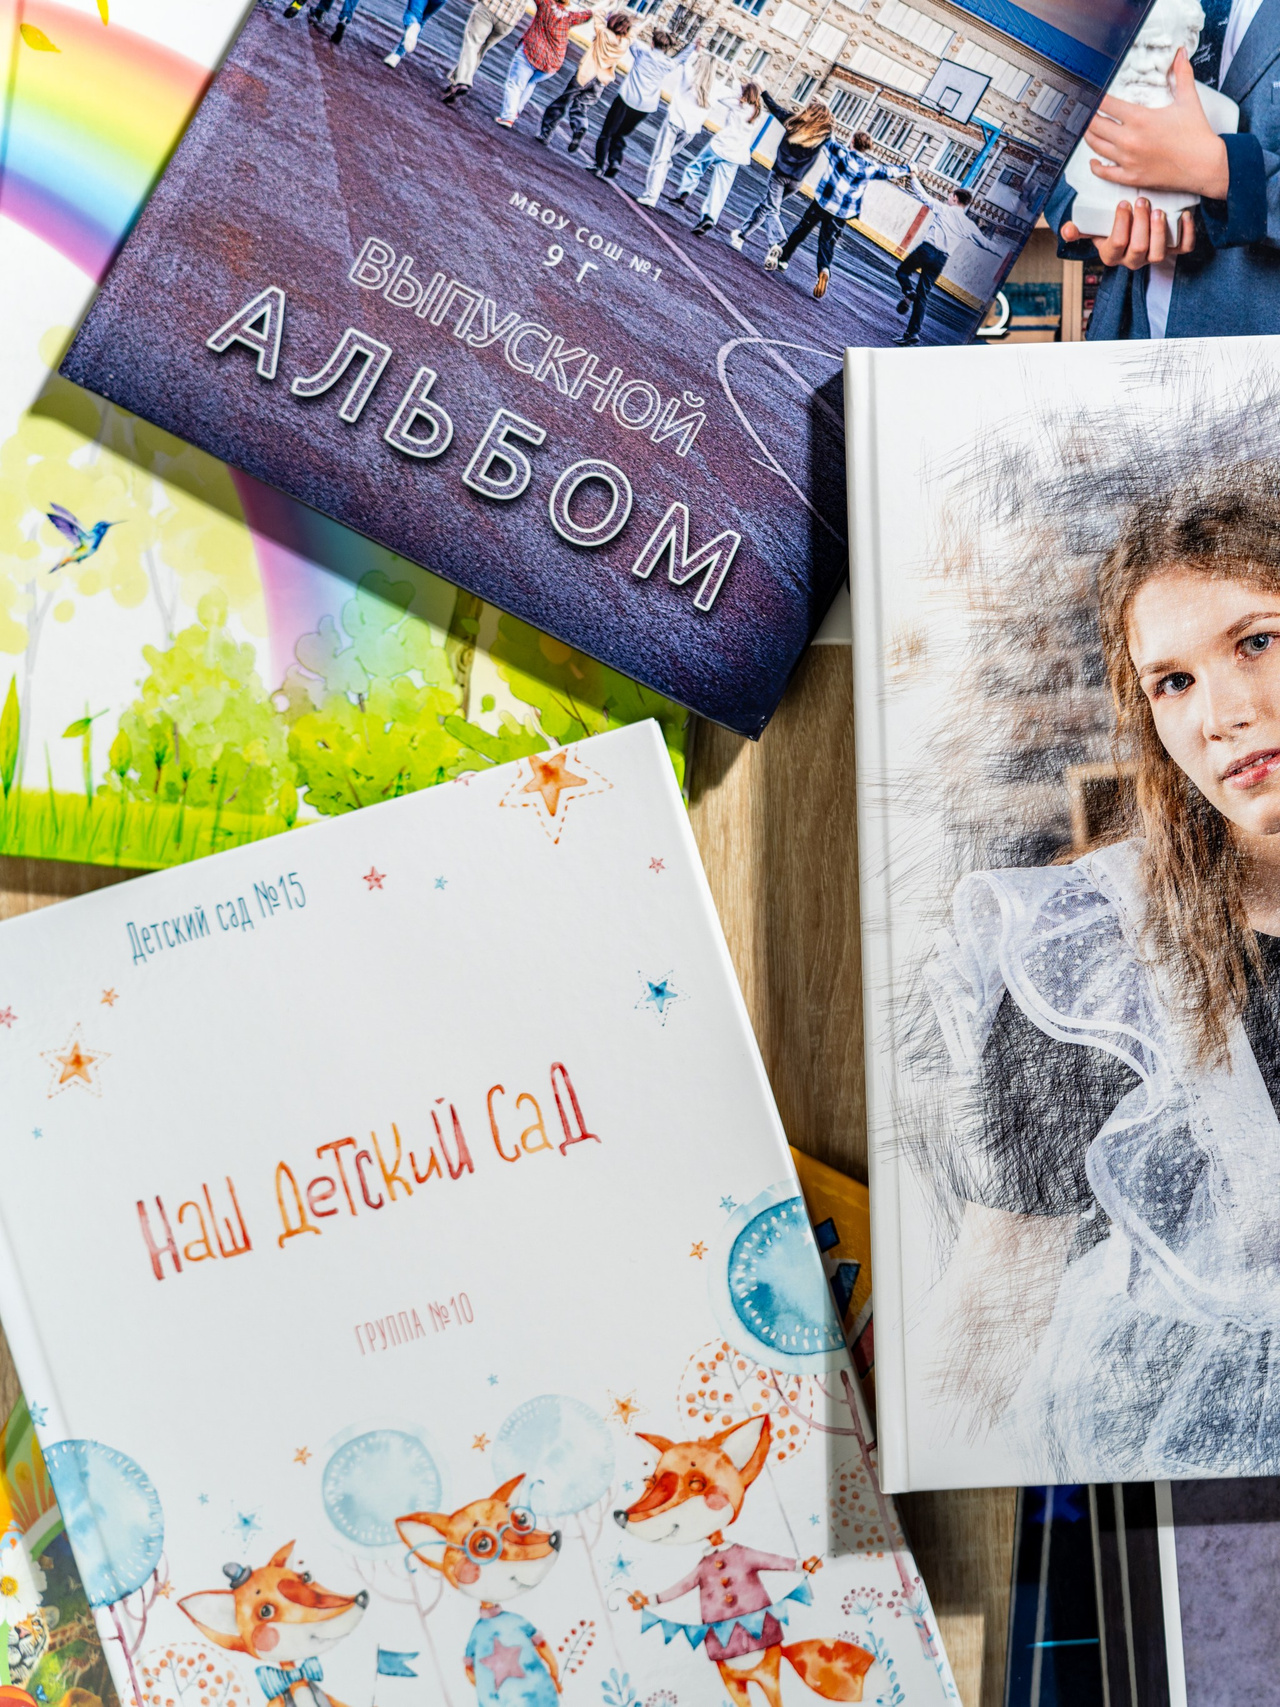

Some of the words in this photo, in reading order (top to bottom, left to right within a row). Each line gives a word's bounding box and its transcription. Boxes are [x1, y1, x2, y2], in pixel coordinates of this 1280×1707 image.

[508, 192, 571, 230] МБОУ
[575, 226, 624, 261] СОШ
[541, 243, 565, 268] 9
[575, 260, 600, 284] Г
[347, 236, 708, 458] ВЫПУСКНОЙ
[206, 285, 743, 614] АЛЬБОМ
[126, 904, 211, 966] Детский
[215, 896, 255, 932] сад
[253, 871, 307, 918] №15
[353, 1307, 427, 1356] ГРУППА
[427, 1291, 476, 1333] №10
